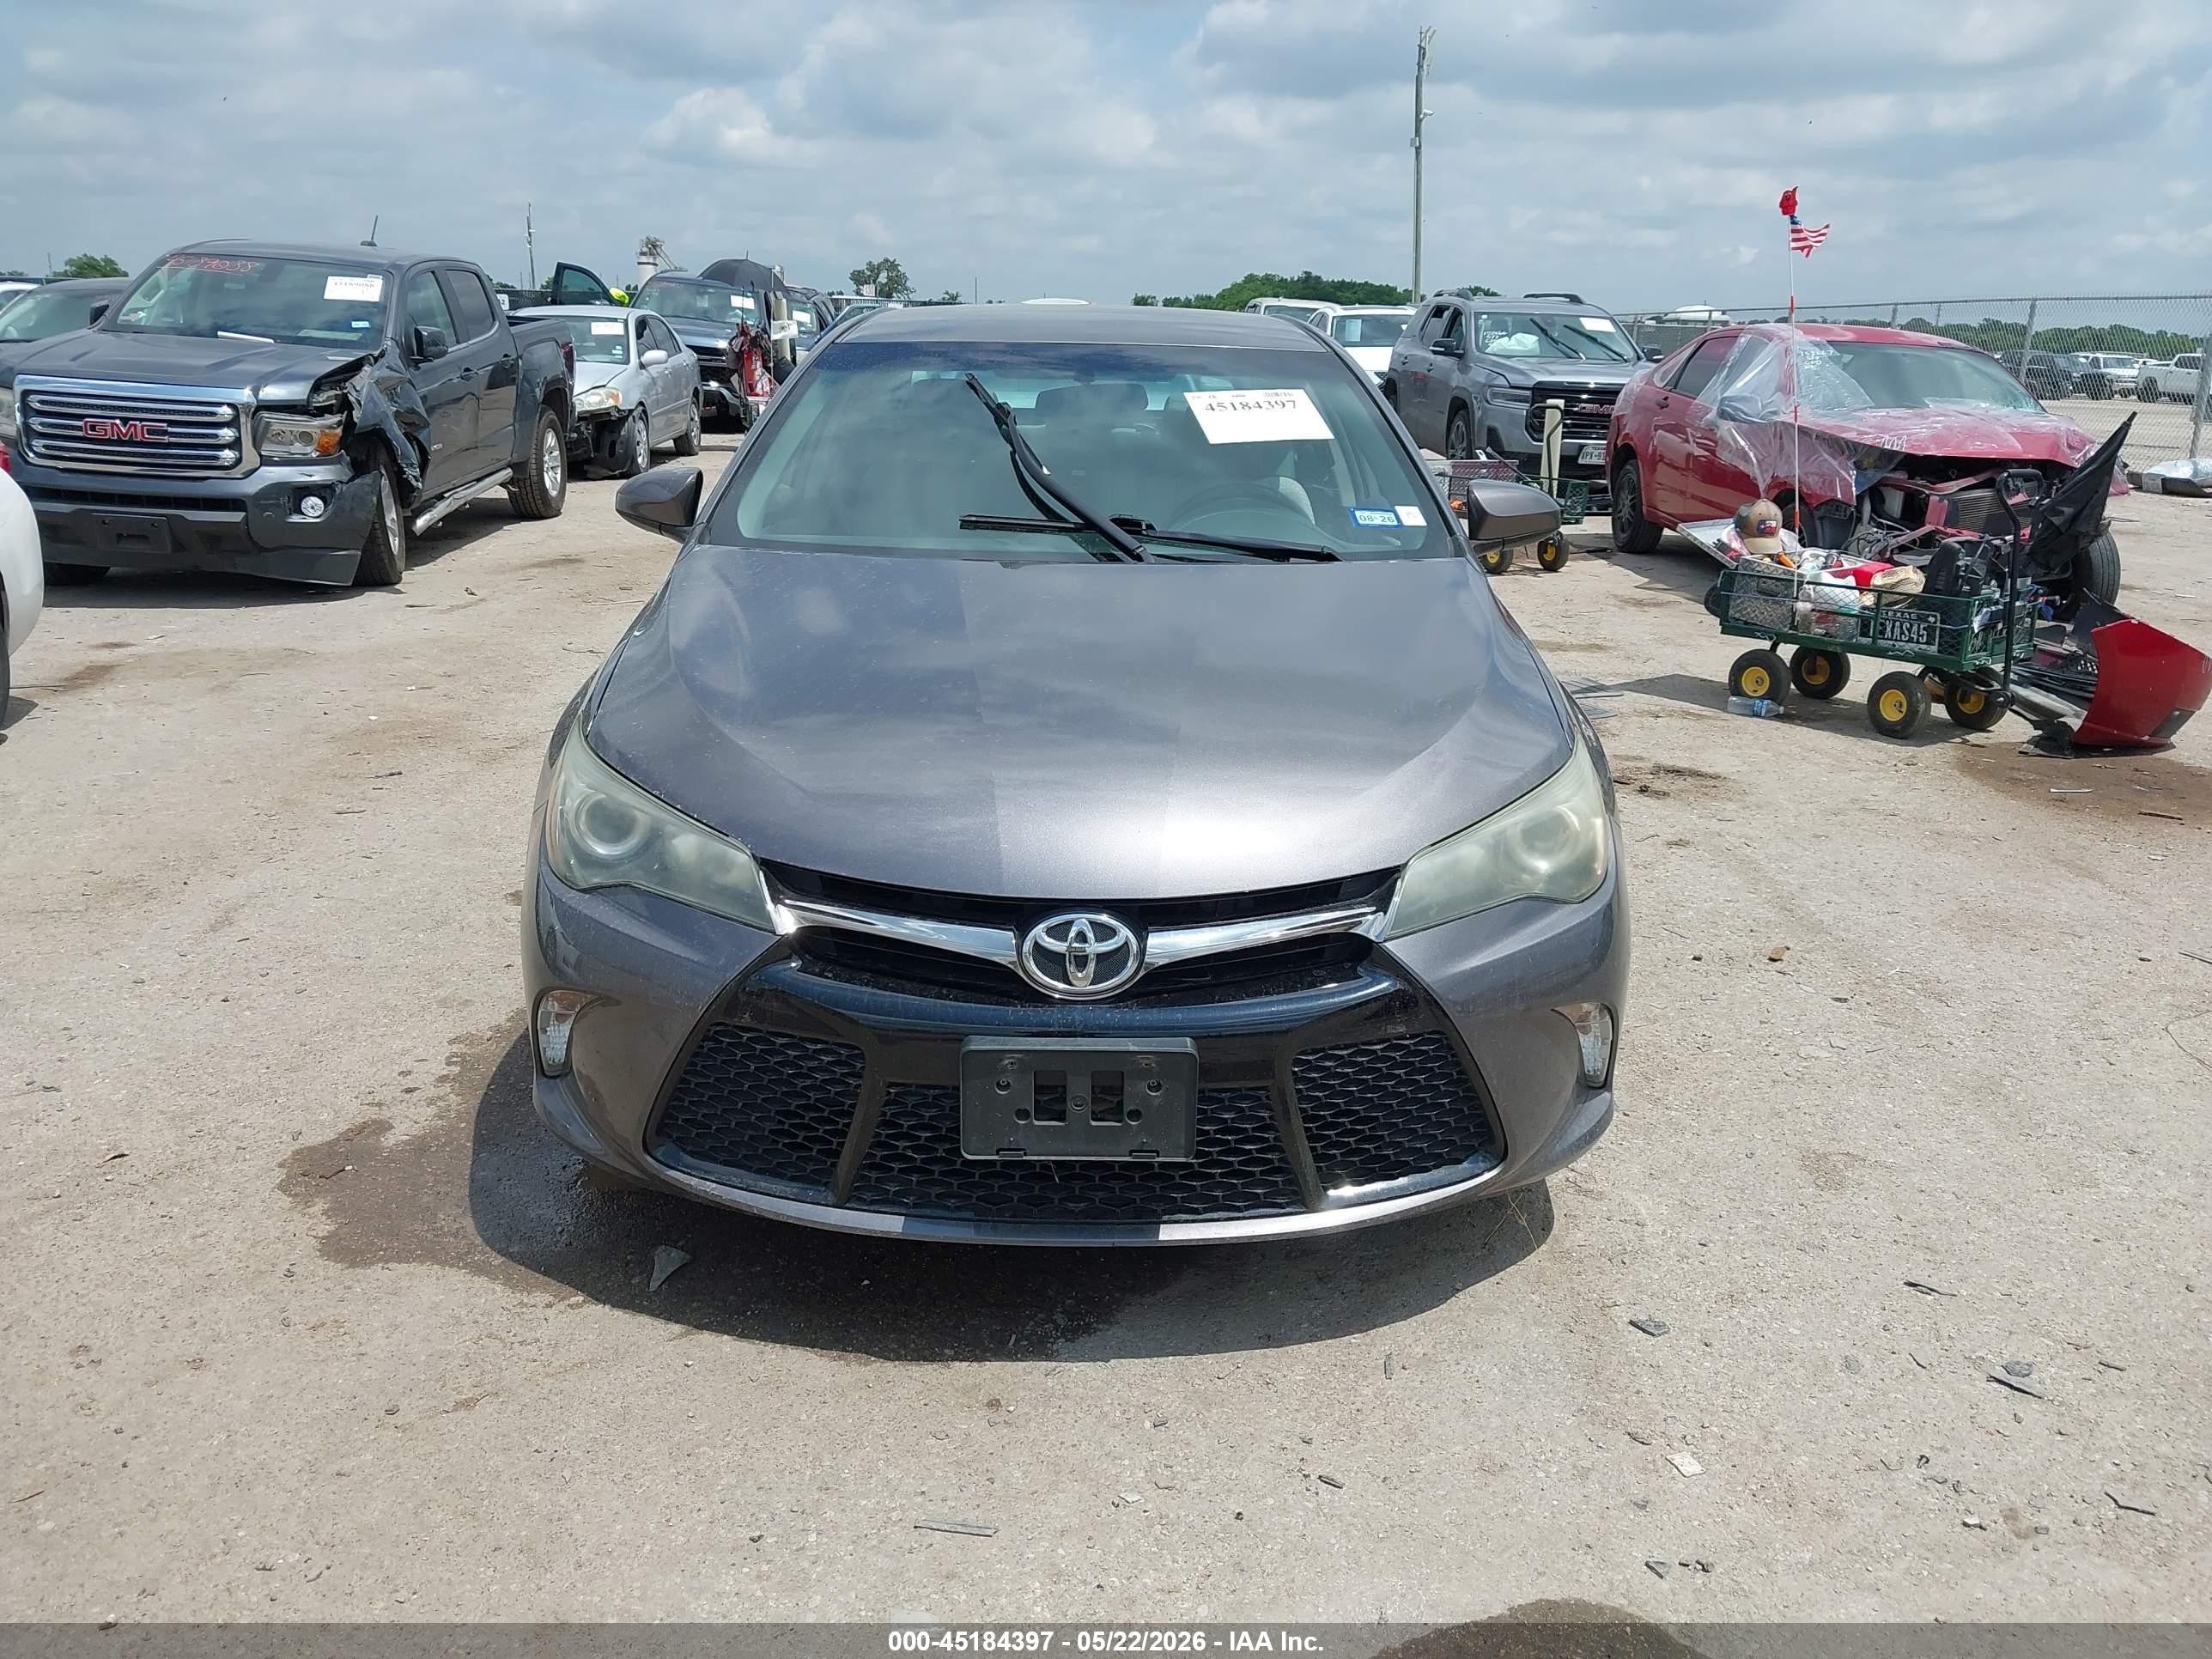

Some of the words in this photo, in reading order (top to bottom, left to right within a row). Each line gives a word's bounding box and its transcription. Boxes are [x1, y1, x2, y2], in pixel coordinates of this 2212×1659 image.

[1205, 399, 1297, 412] 45184397
[82, 418, 169, 443] GMC
[1881, 611, 1917, 620] TEXAS
